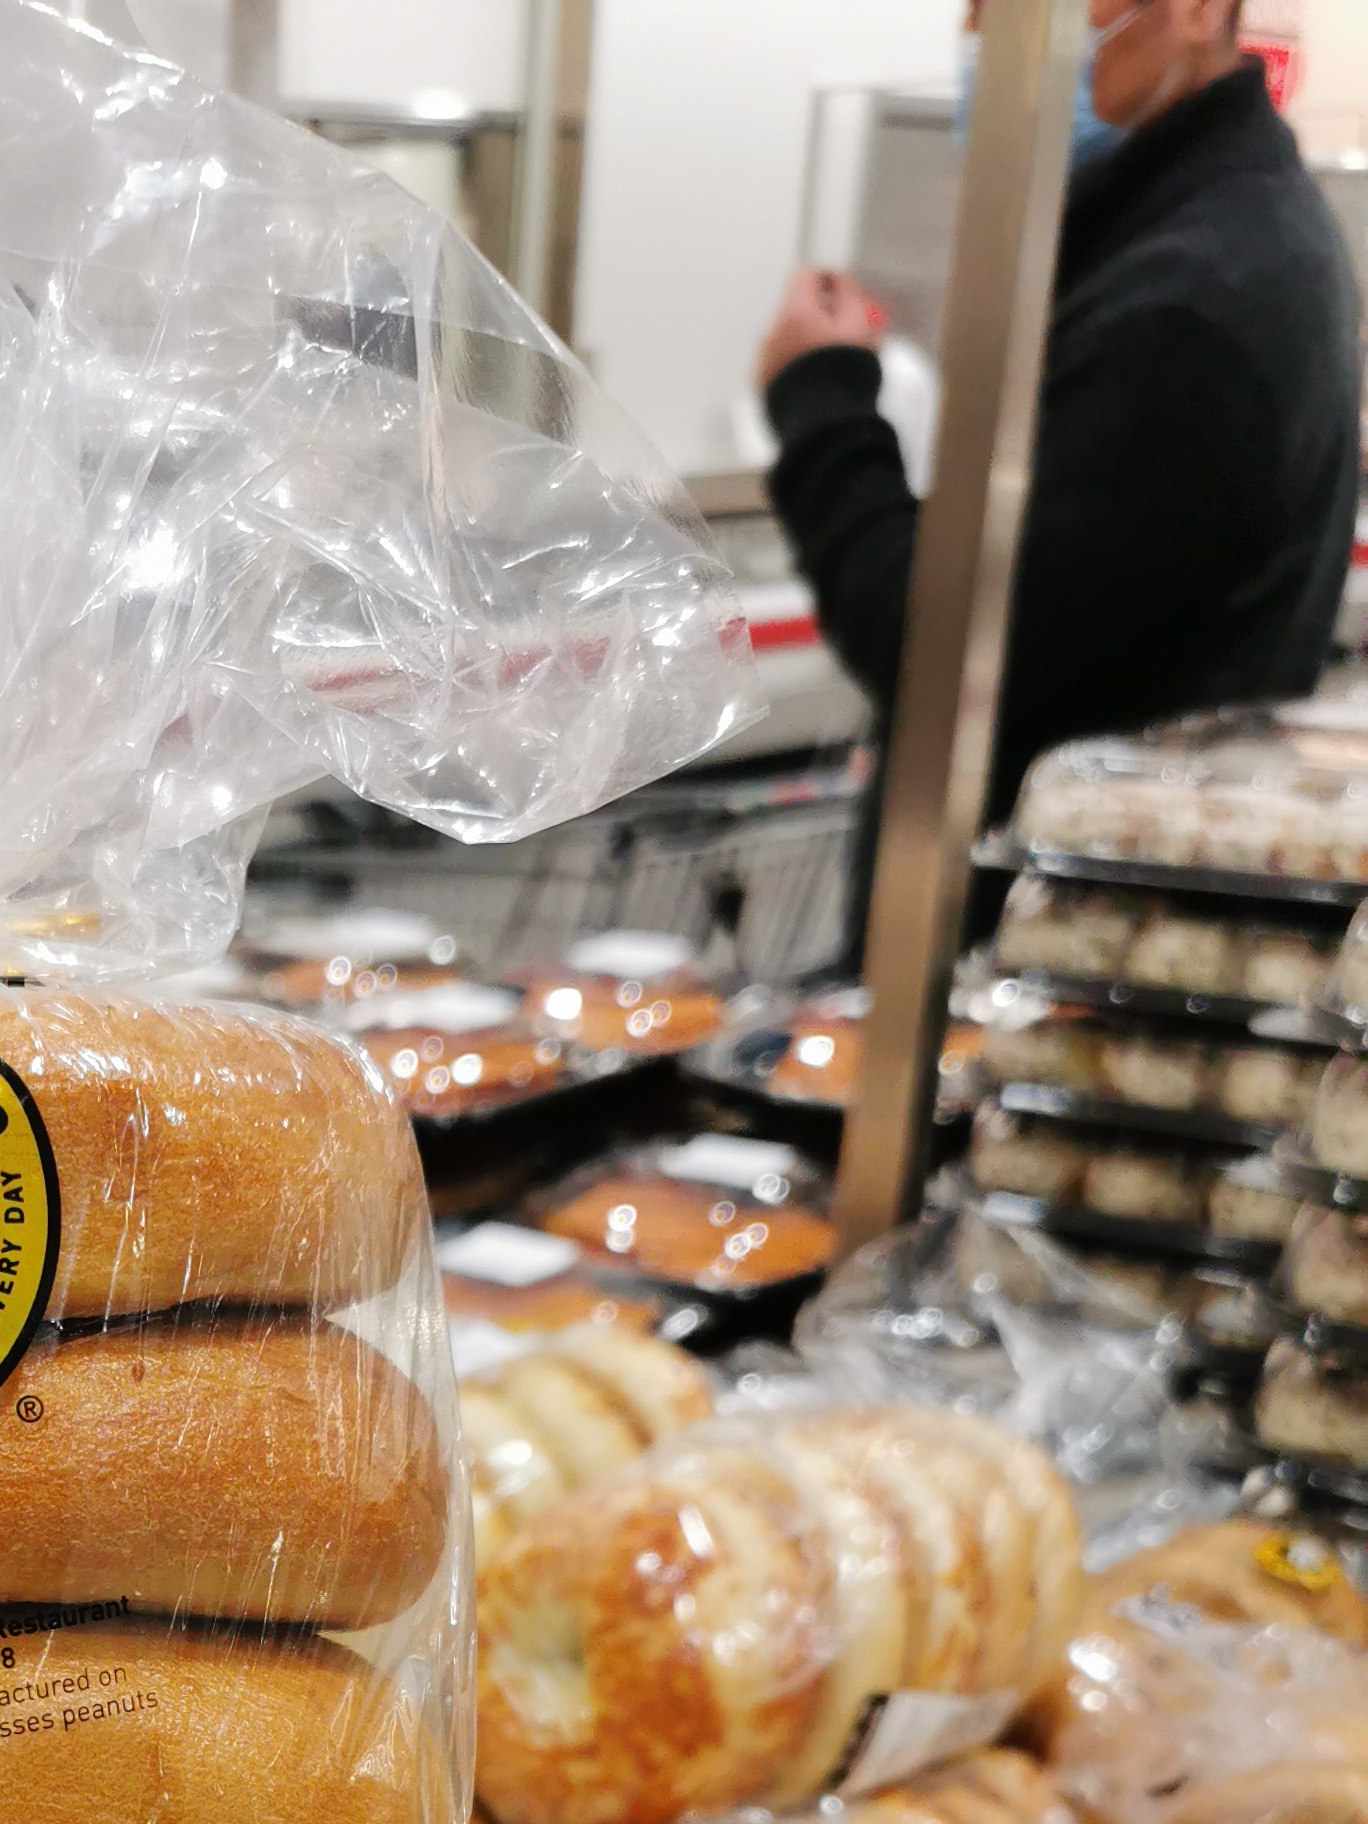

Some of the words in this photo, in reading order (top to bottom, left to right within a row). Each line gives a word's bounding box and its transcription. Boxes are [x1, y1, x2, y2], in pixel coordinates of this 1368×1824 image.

[3, 1170, 25, 1224] DAY
[99, 1664, 128, 1688] on
[62, 1691, 160, 1732] peanuts
